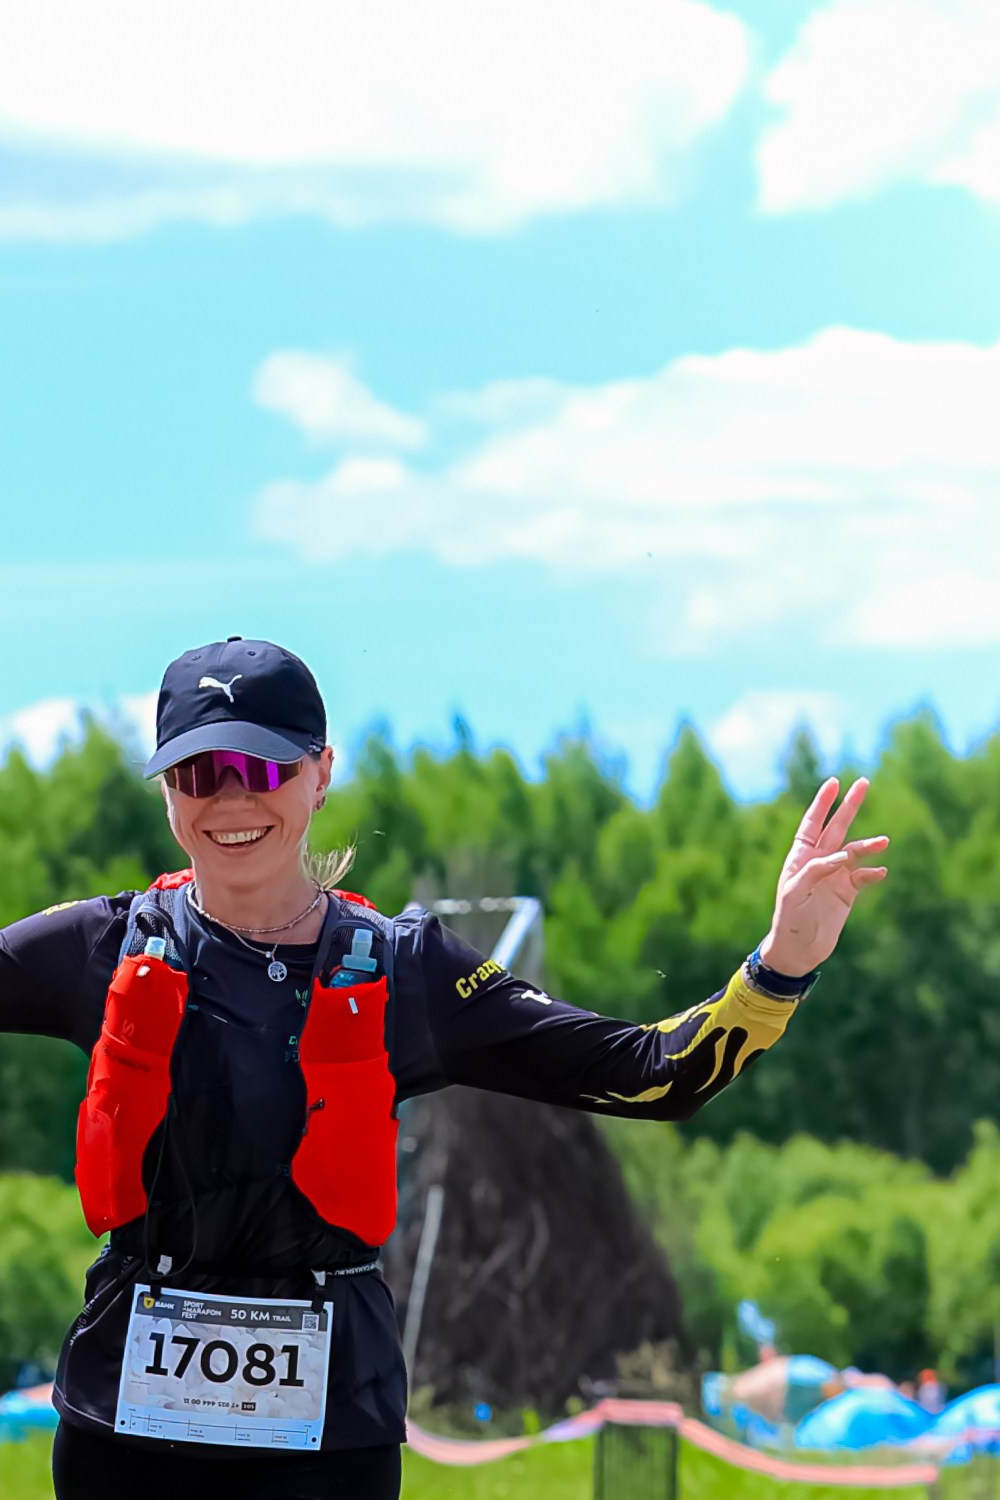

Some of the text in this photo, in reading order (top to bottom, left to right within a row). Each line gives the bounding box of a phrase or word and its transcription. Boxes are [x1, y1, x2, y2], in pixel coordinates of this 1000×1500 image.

[181, 1311, 198, 1319] FEST
[230, 1309, 292, 1322] 50 KM TRAIL
[145, 1332, 305, 1388] 17081
